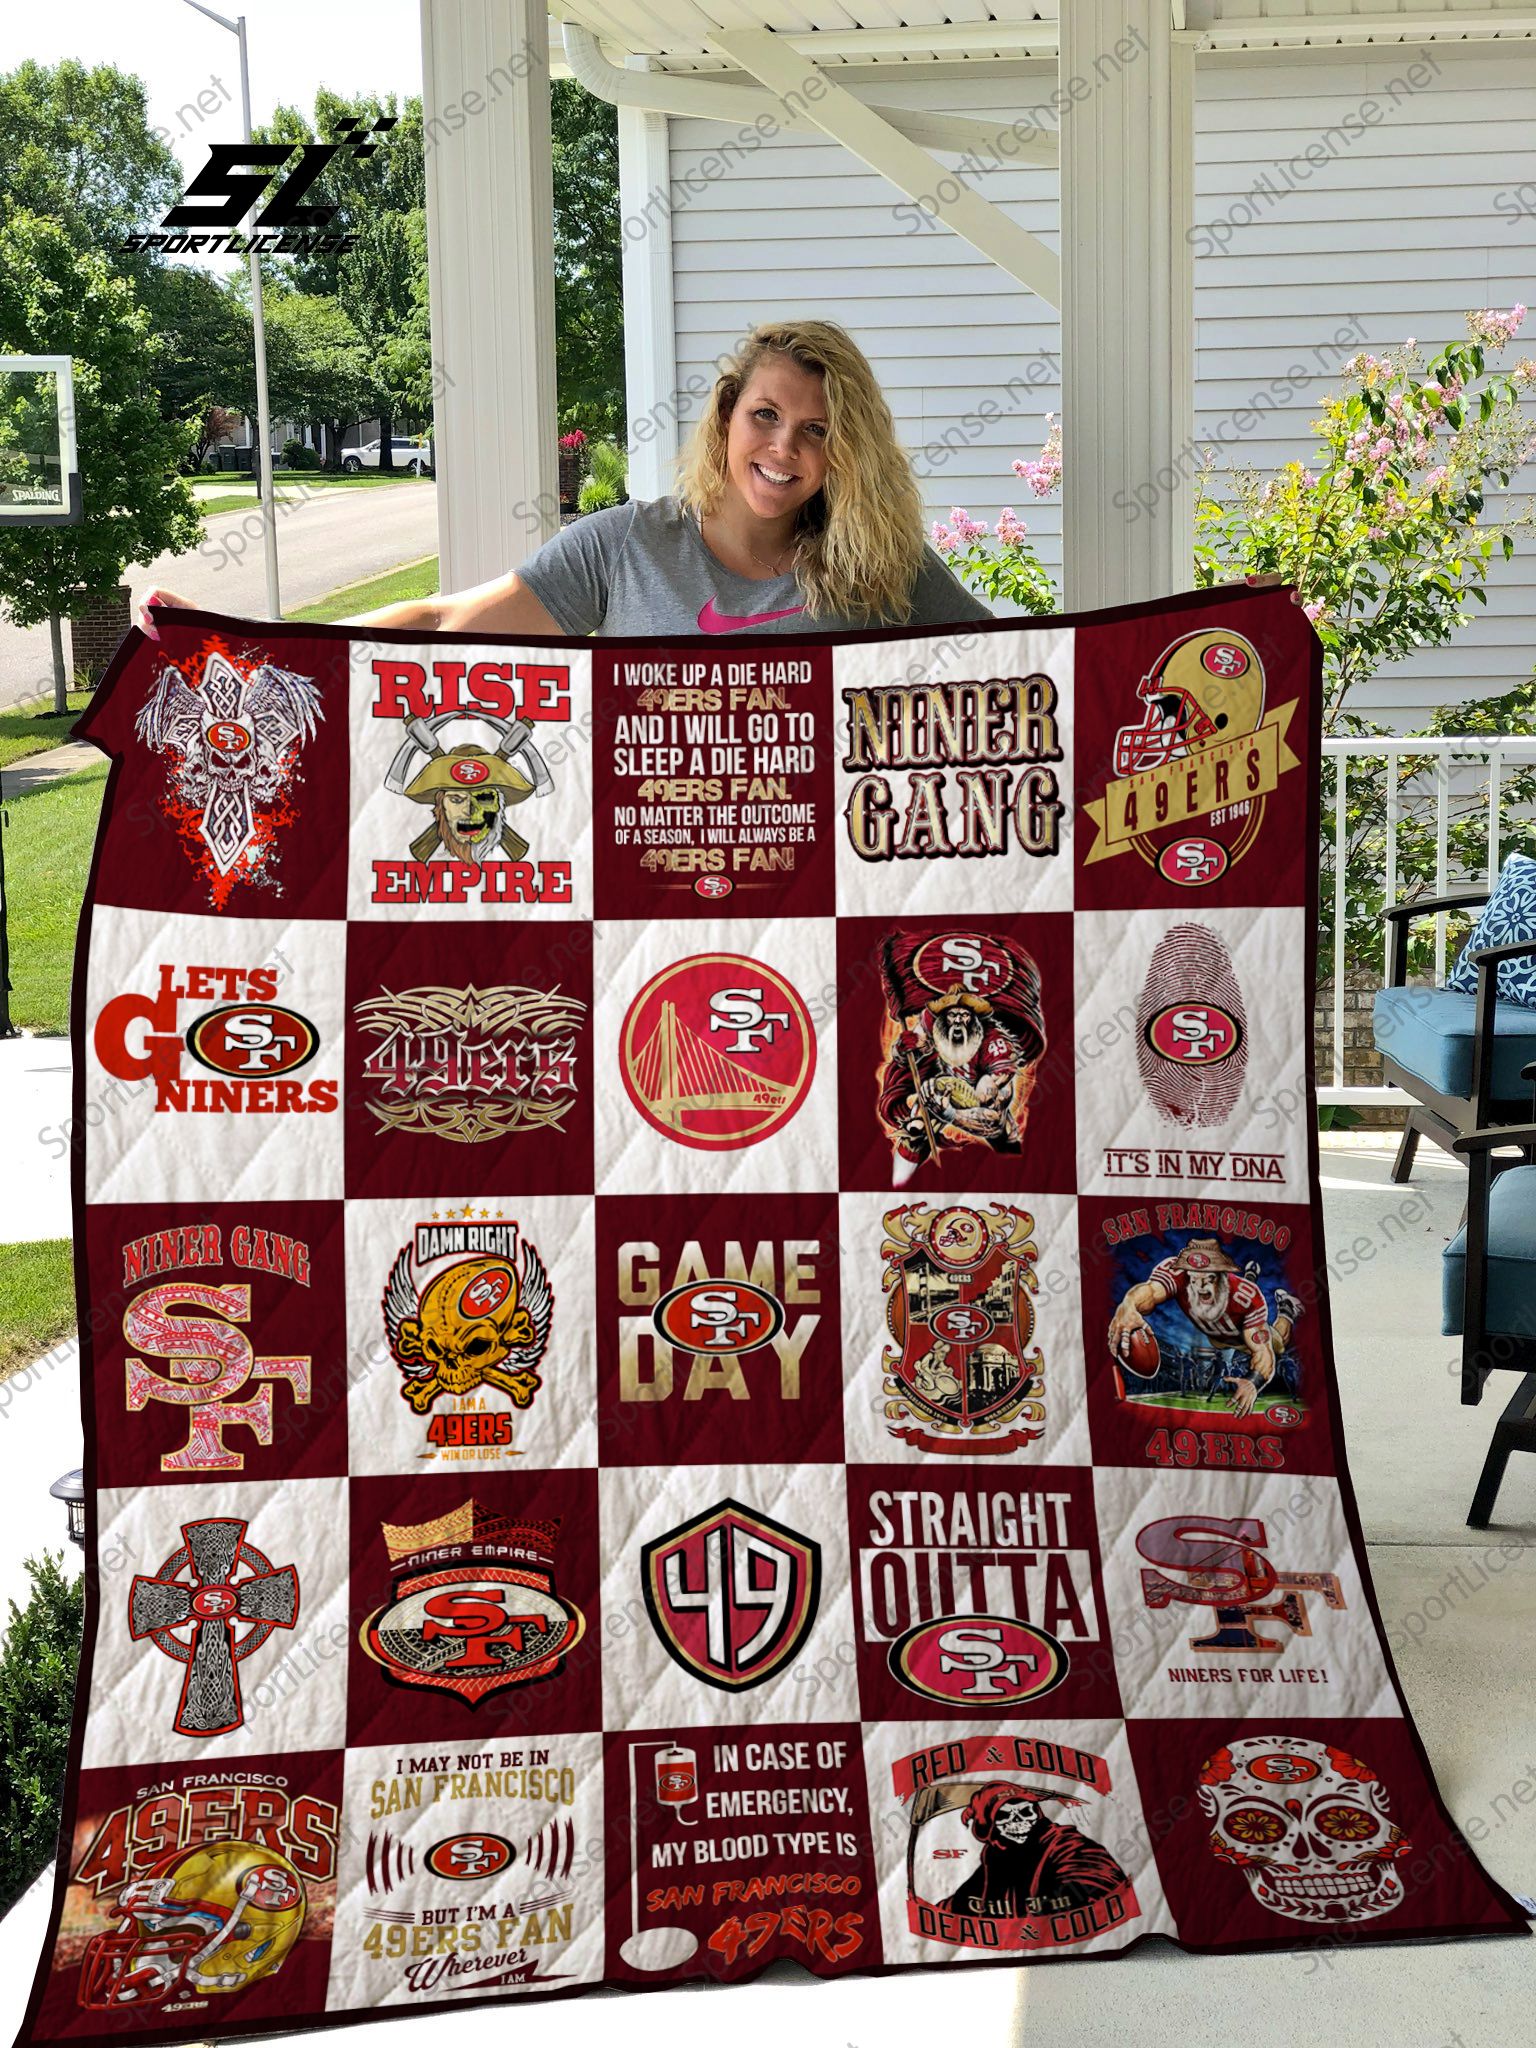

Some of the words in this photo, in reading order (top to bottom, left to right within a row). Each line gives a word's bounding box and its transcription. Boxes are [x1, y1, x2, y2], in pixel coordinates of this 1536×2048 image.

[12, 490, 60, 501] SPALDING
[372, 660, 571, 722] RISE
[614, 663, 619, 686] I
[624, 663, 677, 686] WOKE
[682, 664, 706, 686] UP
[710, 664, 723, 685] A
[728, 663, 757, 685] DIE
[762, 661, 812, 685] HARD
[637, 688, 722, 712] 49ERS
[729, 687, 791, 710] FAN.
[614, 715, 664, 744] AND
[671, 715, 677, 744] I
[684, 714, 742, 744] WILL
[748, 713, 779, 743] GO
[785, 712, 815, 742] TO
[842, 673, 1065, 772] NINER
[614, 747, 684, 776] SLEEP
[689, 747, 705, 776] A
[711, 747, 747, 775] DIE
[754, 745, 815, 775] HARD
[638, 778, 723, 802] 49ERS
[730, 777, 792, 801] FAN.
[1124, 749, 1260, 831] 49ERS
[614, 806, 636, 826] NO
[640, 806, 703, 826] MATTER
[707, 805, 737, 825] THE
[742, 803, 816, 825] OUTCOME
[842, 767, 1065, 863] GANG
[1210, 809, 1226, 827] EST
[615, 829, 631, 844] OF
[633, 829, 641, 844] A
[644, 829, 695, 845] SEASON,
[701, 829, 704, 843] I
[707, 828, 734, 844] WILL
[738, 827, 786, 843] ALWAYS
[789, 827, 804, 842] BE
[807, 826, 816, 842] A
[640, 848, 725, 872] 49ERS
[733, 847, 795, 871] FAN!
[371, 860, 571, 904] EMPIRE
[158, 964, 278, 1002] LETS
[709, 988, 790, 1053] SF
[363, 1022, 579, 1098] 49ers
[987, 1038, 1007, 1056] 49
[155, 1081, 338, 1114] NINERS
[1158, 1154, 1181, 1176] IN
[1189, 1155, 1224, 1178] MY
[1232, 1157, 1282, 1180] DNA
[418, 1227, 465, 1260] DAMN
[467, 1225, 517, 1260] RIGHT
[1102, 1208, 1151, 1245] SAN
[1156, 1203, 1292, 1251] FRANCISCO
[122, 1224, 223, 1289] NINER
[231, 1224, 311, 1288] GANG
[617, 1240, 821, 1306] GAME
[618, 1314, 821, 1402] DAY
[453, 1398, 456, 1411] I
[459, 1398, 477, 1411] AM
[479, 1397, 486, 1410] A
[427, 1412, 513, 1447] 49ERS
[441, 1449, 460, 1461] WIN
[462, 1449, 475, 1460] OR
[478, 1449, 501, 1460] LOSE
[1146, 1428, 1285, 1468] 49ERS
[869, 1490, 1072, 1548] STRAIGHT
[663, 1523, 794, 1673] 49
[869, 1550, 1091, 1642] OUTTA
[1168, 1667, 1232, 1685] NINERS
[1239, 1668, 1275, 1684] FOR
[1280, 1668, 1329, 1685] LIFE!
[396, 1760, 403, 1774] I
[409, 1756, 451, 1774] MAY
[456, 1754, 493, 1770] NOT
[500, 1752, 523, 1768] BE
[530, 1750, 550, 1766] IN
[714, 1744, 739, 1772] IN
[745, 1742, 810, 1771] CASE
[816, 1741, 847, 1769] OF
[911, 1742, 967, 1788] RED
[1014, 1739, 1096, 1784] GOLD
[136, 1781, 175, 1800] SAN
[183, 1772, 288, 1788] FRANCISCO
[370, 1777, 422, 1820] SAN
[433, 1768, 575, 1806] FRANCISCO
[706, 1787, 854, 1819] EMERGENCY,
[73, 1786, 339, 1898] 49ERS
[652, 1842, 687, 1868] MY
[694, 1834, 768, 1865] BLOOD
[773, 1832, 831, 1856] TYPE
[836, 1832, 857, 1857] IS
[933, 1849, 968, 1860] SF
[646, 1884, 704, 1912] SAN
[712, 1873, 861, 1905] FRANCISCO
[967, 1896, 1012, 1915] Till
[363, 1922, 482, 1960] 49ERS
[496, 1904, 574, 1948] FAN
[422, 1907, 460, 1926] BUT
[466, 1904, 496, 1922] I'M
[503, 1903, 516, 1918] A
[918, 1905, 999, 1946] DEAD
[1050, 1894, 1126, 1943] COLD
[707, 1904, 865, 1966] 49ERS
[404, 1948, 528, 1992] Wherever
[501, 1974, 506, 1984] I
[507, 1973, 526, 1984] AM
